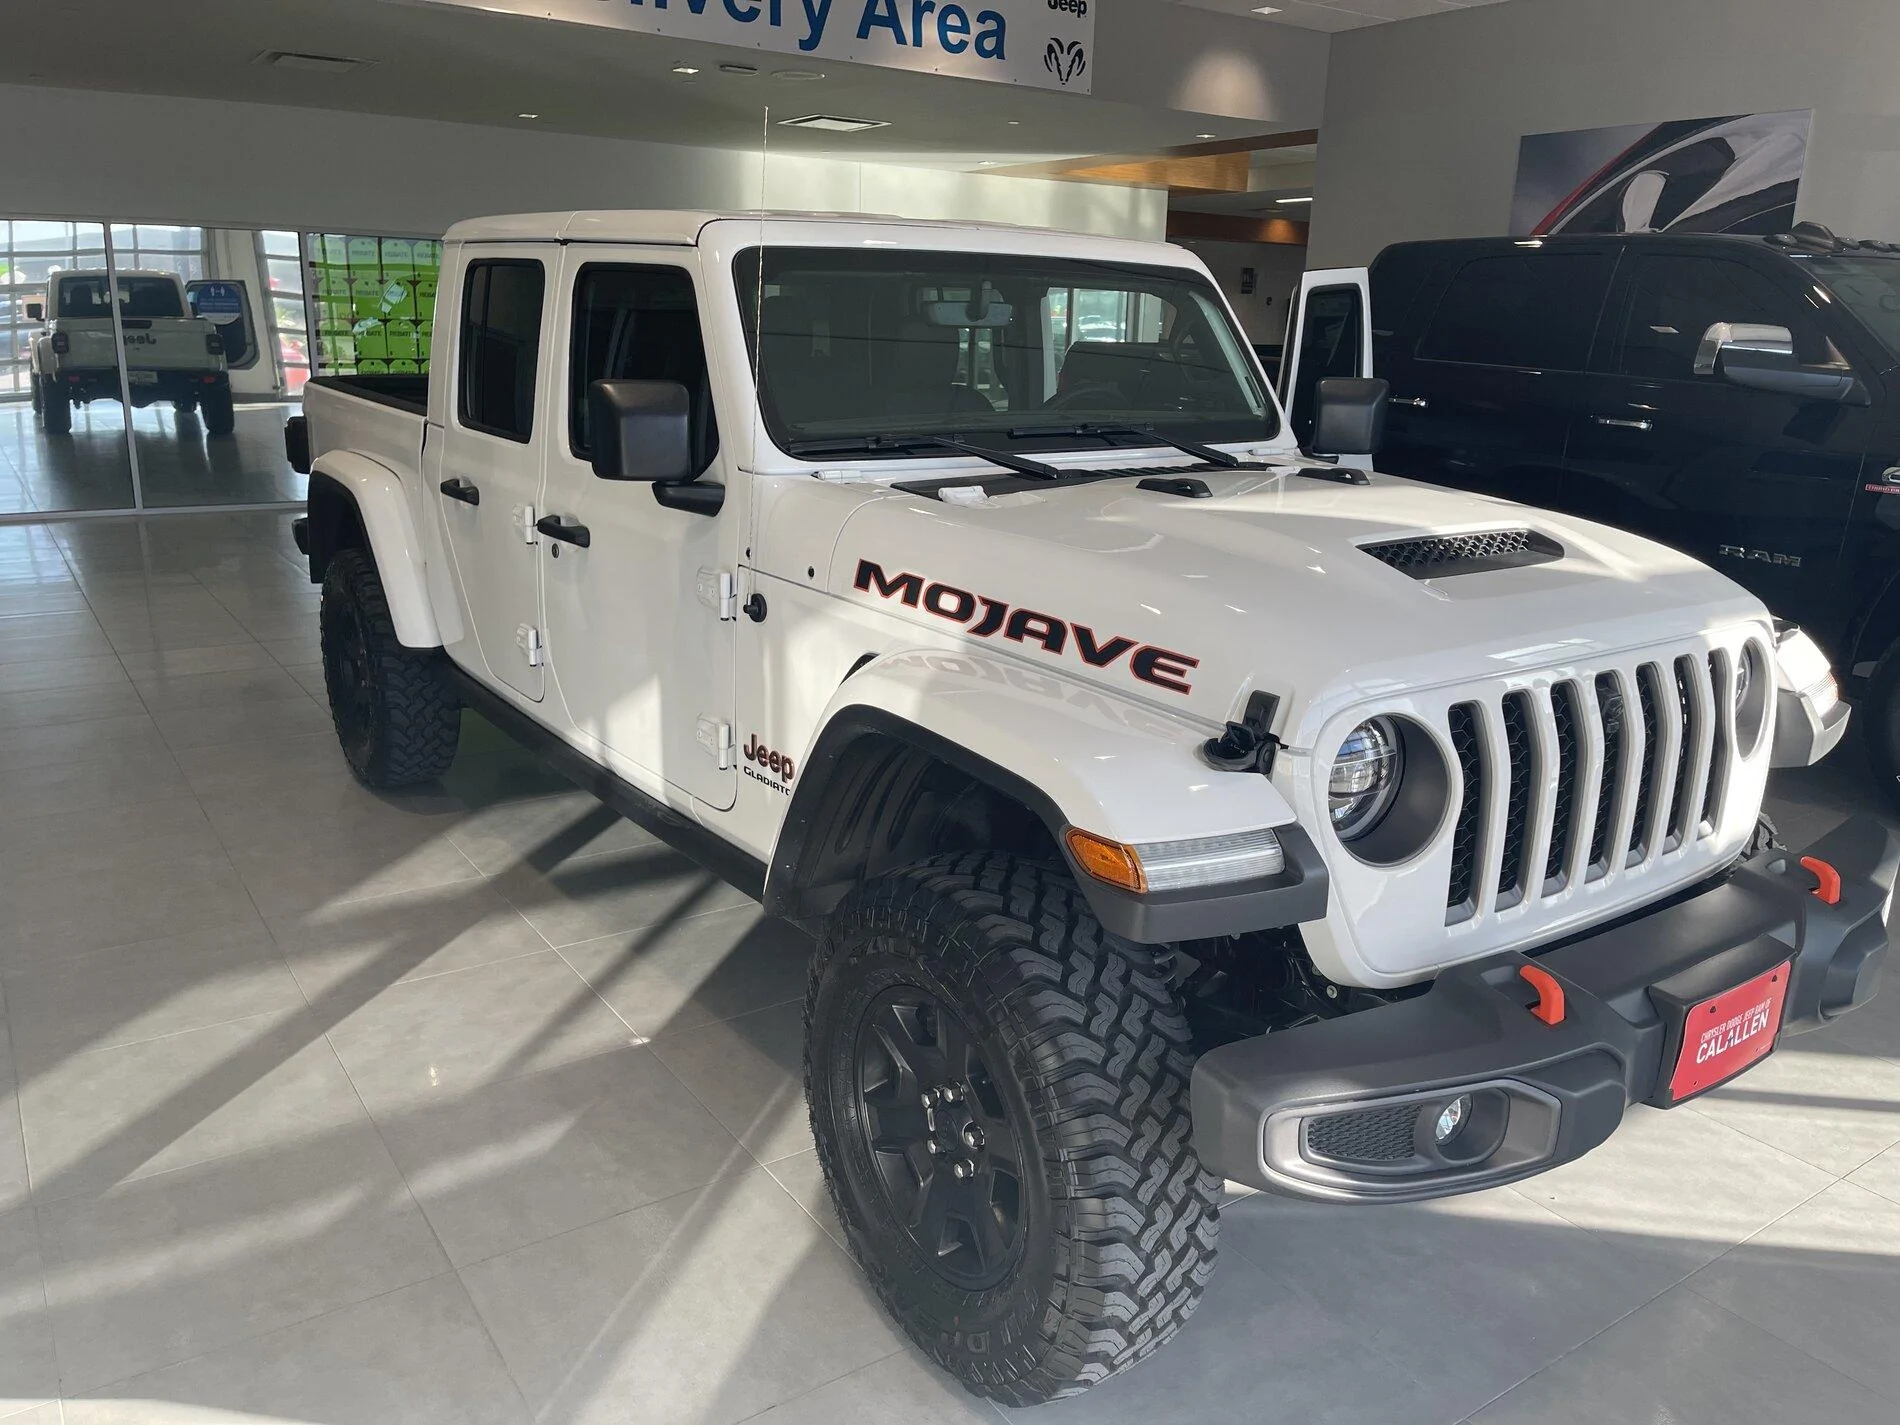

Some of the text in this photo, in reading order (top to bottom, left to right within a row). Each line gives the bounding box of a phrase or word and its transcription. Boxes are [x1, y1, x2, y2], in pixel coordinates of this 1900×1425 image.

[855, 0, 1007, 60] Area
[1719, 543, 1802, 567] RAM
[853, 558, 1200, 695] MOJAVE
[743, 733, 795, 783] Jeep
[743, 765, 791, 796] GLADIATO
[1696, 1008, 1769, 1064] CALALLEN
[1701, 1022, 1727, 1043] CHRYSLER
[1726, 1013, 1743, 1031] DODGE
[1742, 1007, 1755, 1022] JEEP
